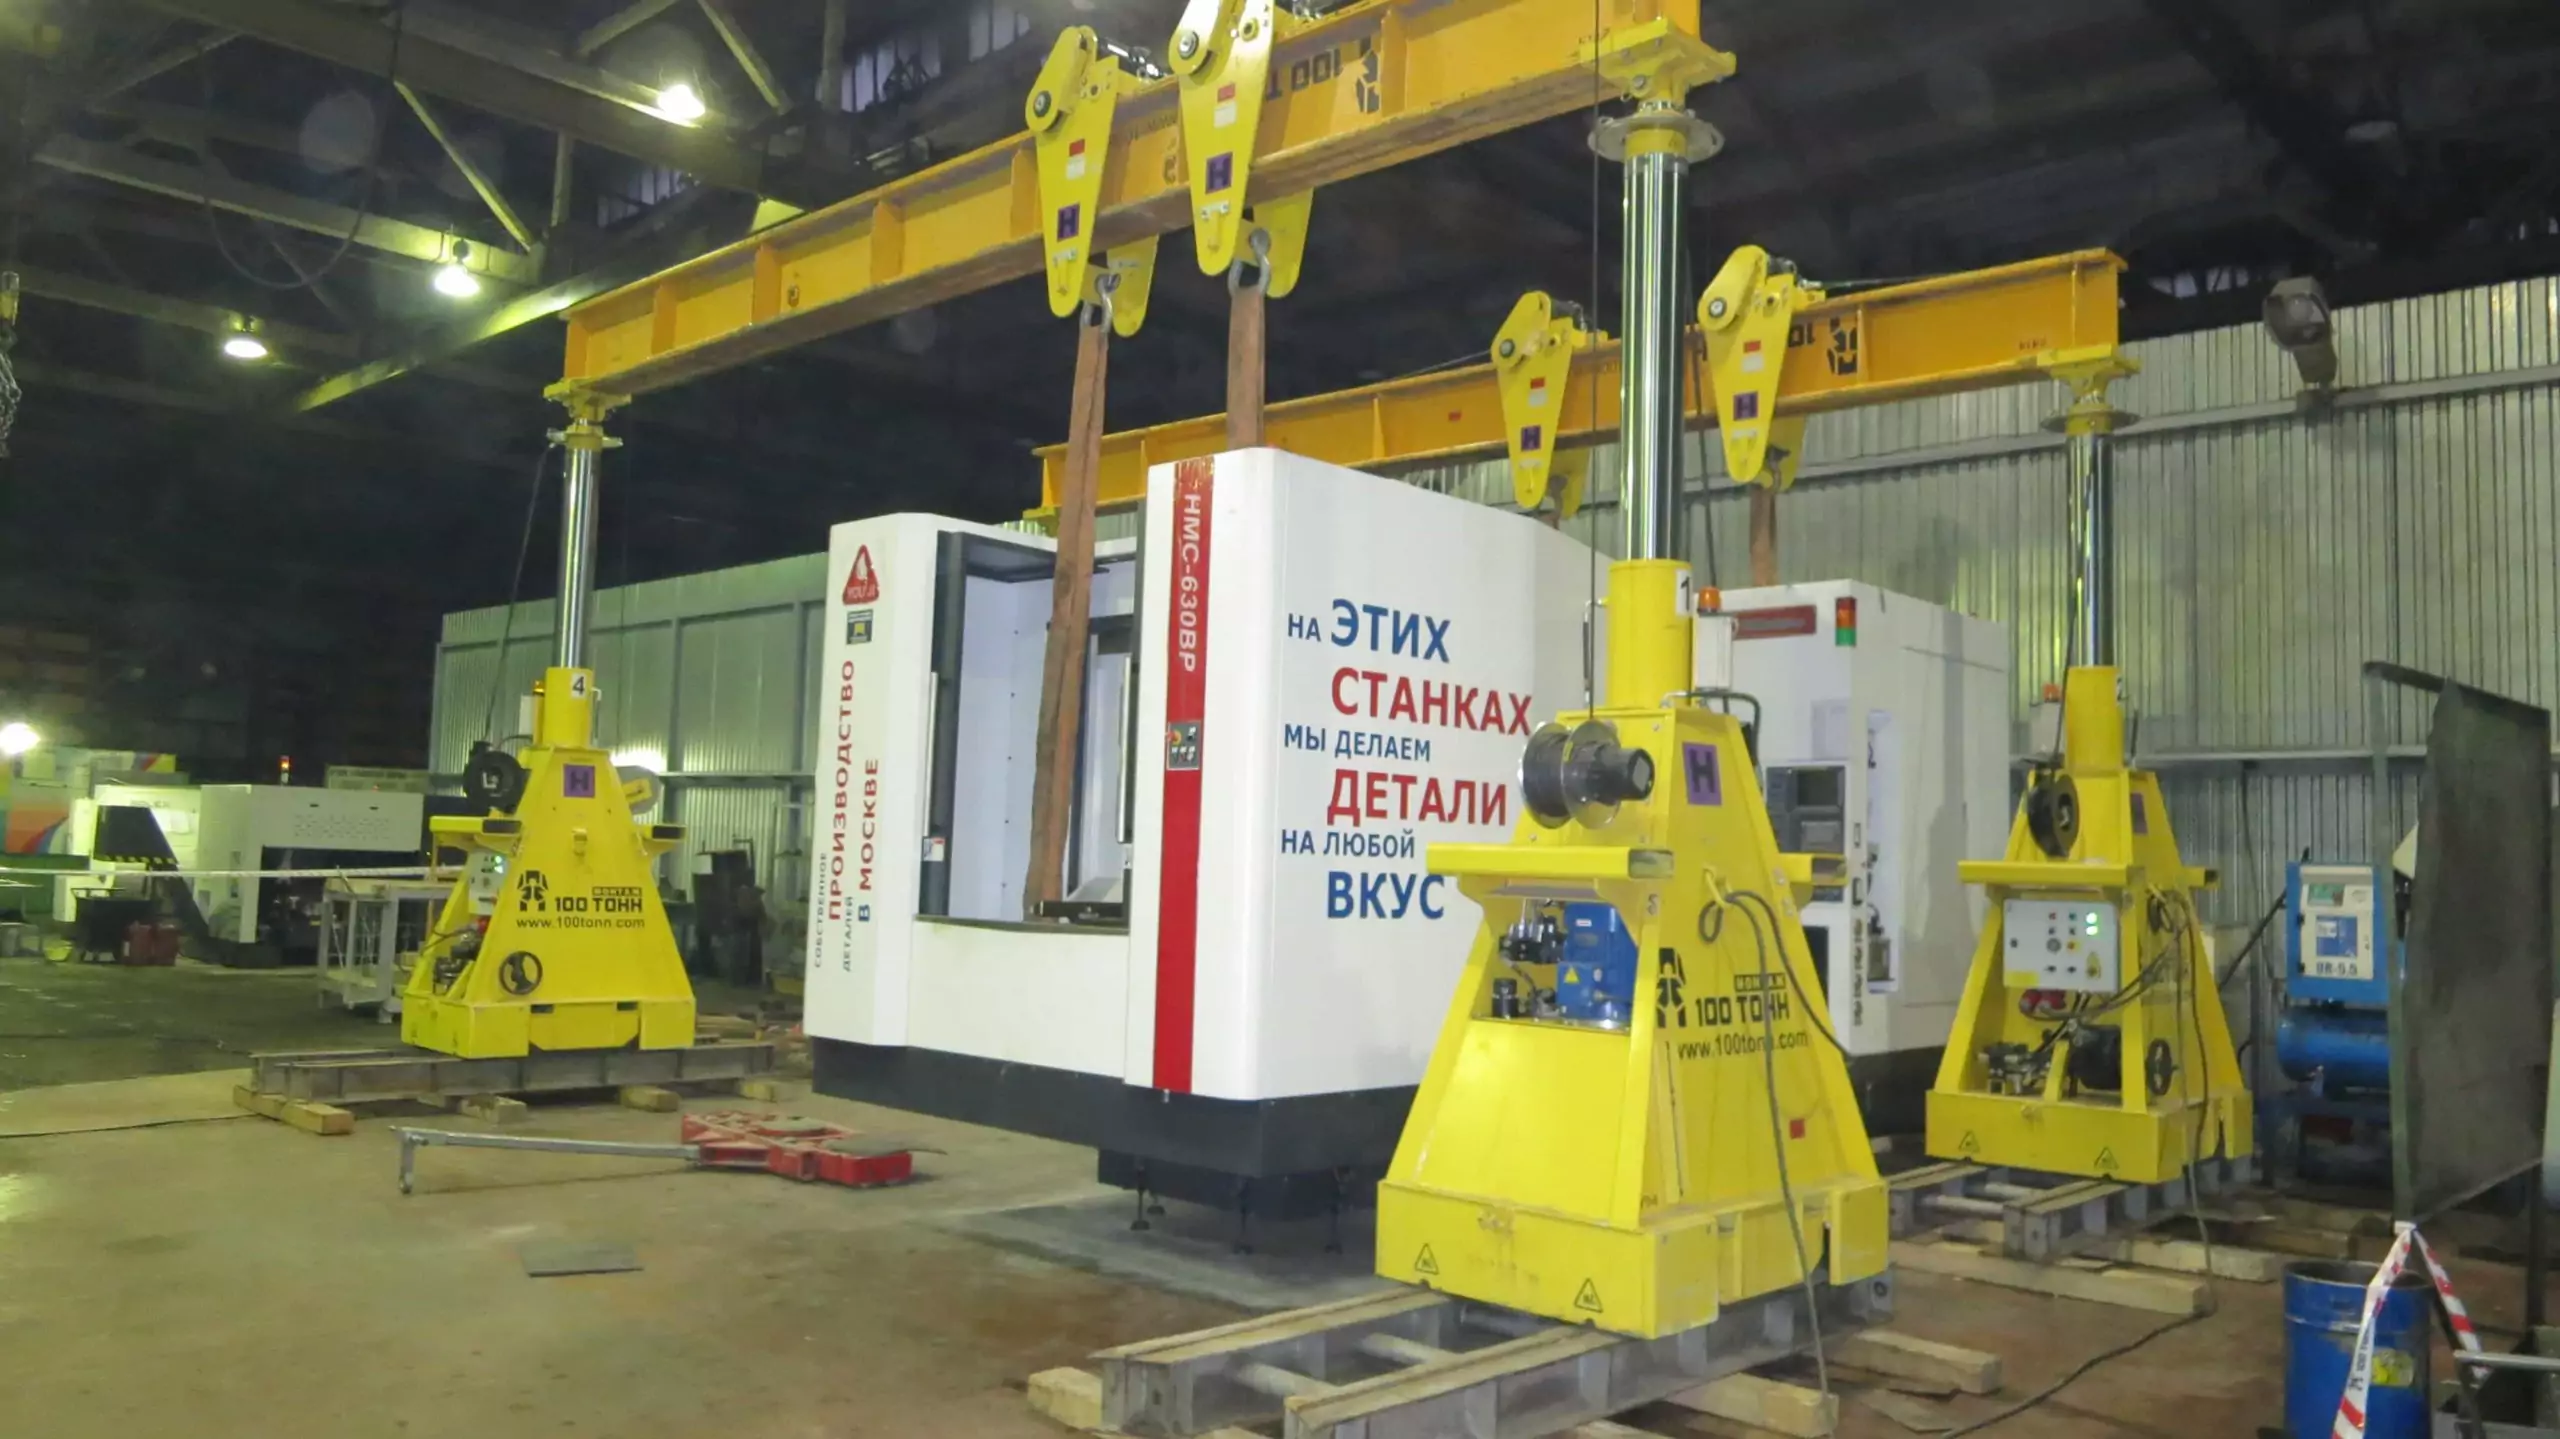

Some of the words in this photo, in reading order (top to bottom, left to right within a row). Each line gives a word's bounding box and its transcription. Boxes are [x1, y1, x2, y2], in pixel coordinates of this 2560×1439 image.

[1179, 494, 1201, 672] HMC-630BP
[1680, 575, 1691, 612] 1
[1288, 613, 1321, 642] НА
[1331, 598, 1451, 663] ЭТИХ
[572, 676, 586, 696] 4
[1331, 667, 1532, 736] СТАНКАХ
[1284, 724, 1326, 752] МЫ
[1334, 730, 1431, 762] ДЕЛАЕМ
[829, 660, 854, 920] ПРОИЗВОДСТВО
[1327, 768, 1506, 827] ДЕТАЛИ
[859, 759, 878, 891] МОСКВЕ
[1281, 829, 1315, 855] НА
[1323, 828, 1415, 859] ЛЮБОЙ
[555, 897, 587, 912] 100
[592, 898, 642, 912] ТОНН
[815, 853, 827, 968] СОБСТВЕННОЕ
[858, 904, 870, 922] В
[1327, 871, 1445, 920] ВКУС
[516, 915, 645, 929] www.100tonn.com
[843, 896, 853, 972] ДЕТАЛЕЙ
[1696, 996, 1732, 1027] 100
[1677, 1029, 1809, 1060] www.100ton.com
